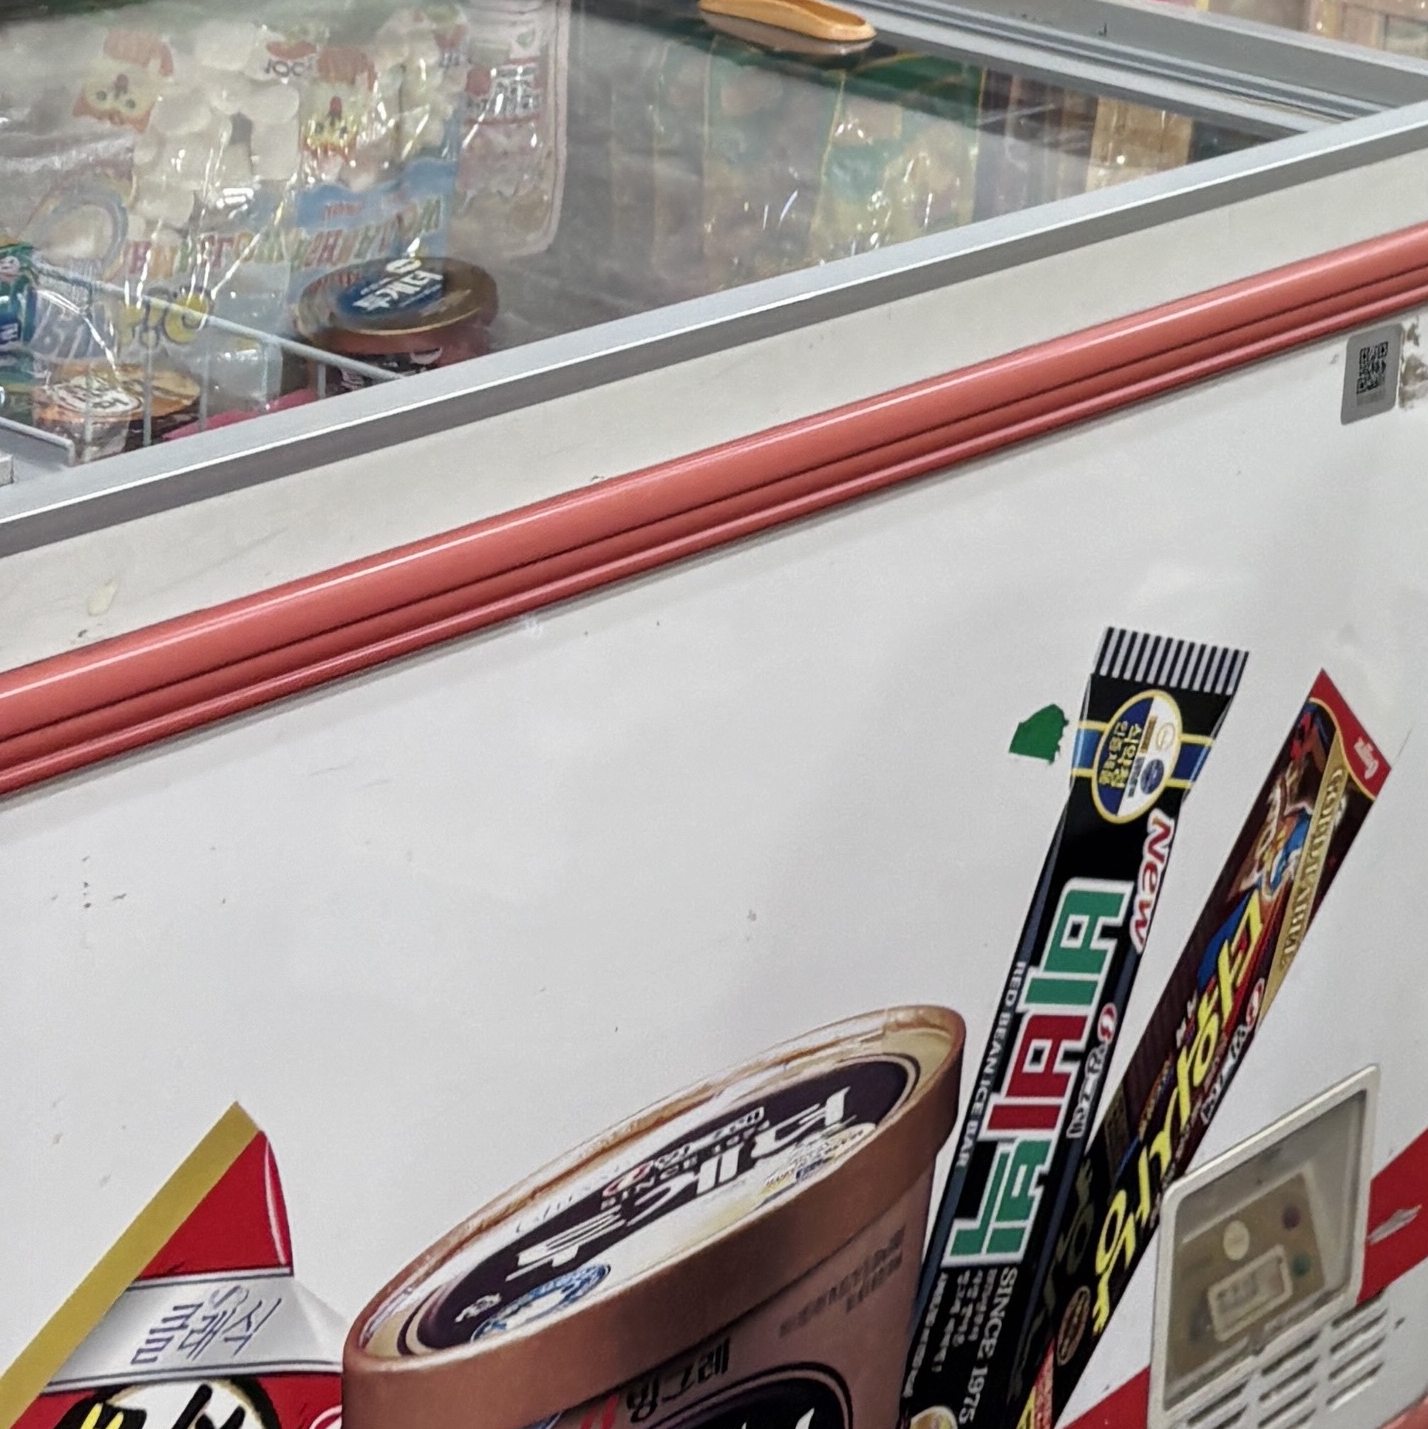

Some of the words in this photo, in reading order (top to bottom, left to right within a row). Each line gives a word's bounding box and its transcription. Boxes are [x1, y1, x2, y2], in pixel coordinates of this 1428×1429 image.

[1131, 809, 1174, 957] New
[948, 878, 1134, 1267] 비비빅
[131, 1297, 284, 1367] 클래식
[982, 1267, 1018, 1361] SINCE
[957, 1360, 986, 1427] 1975
